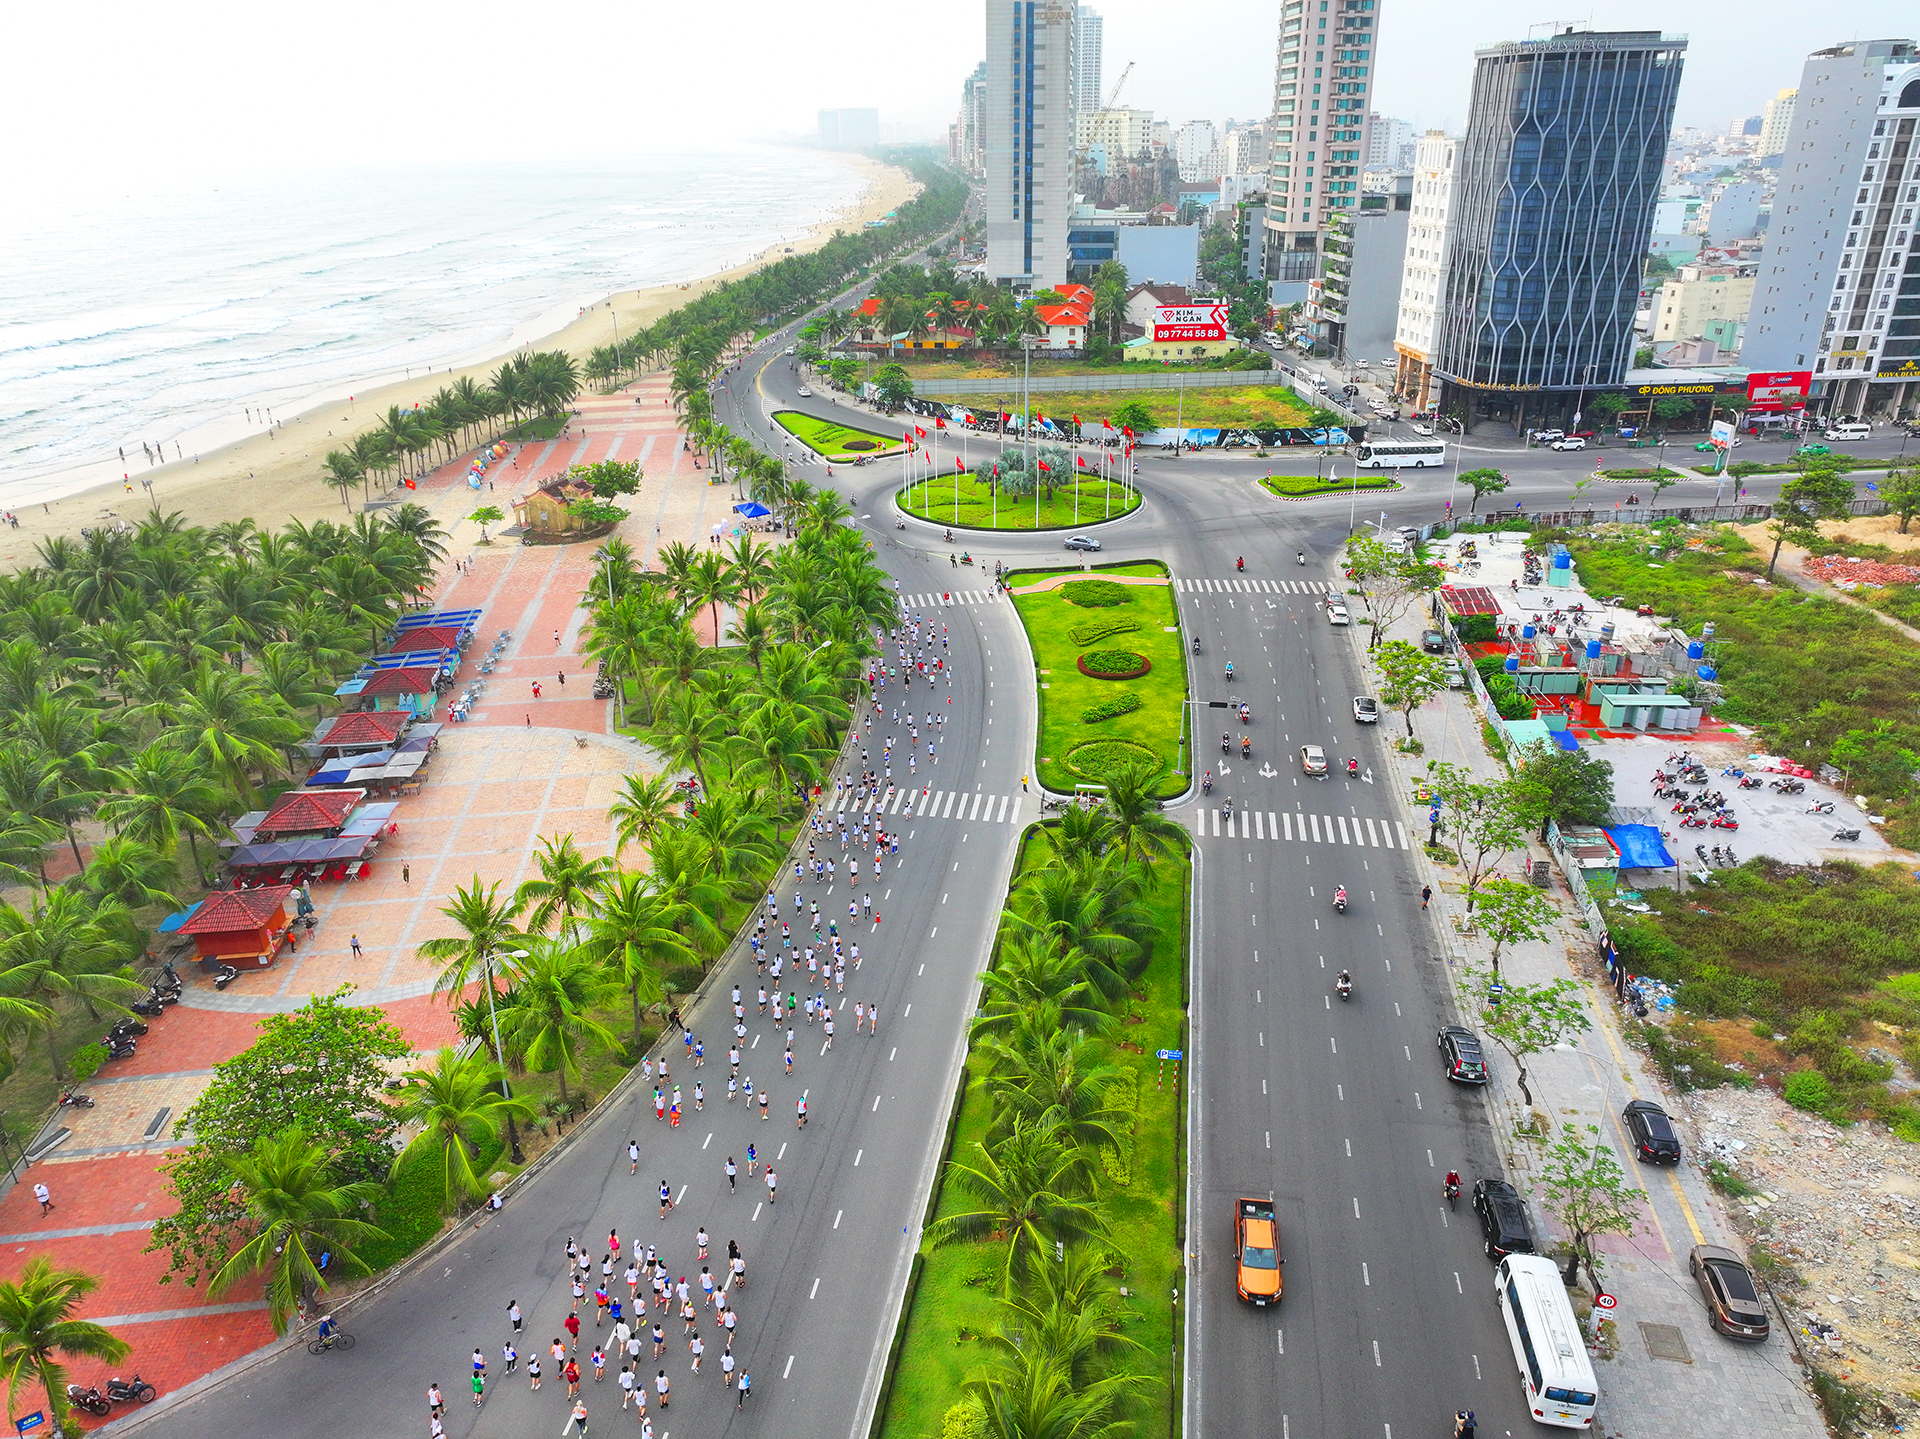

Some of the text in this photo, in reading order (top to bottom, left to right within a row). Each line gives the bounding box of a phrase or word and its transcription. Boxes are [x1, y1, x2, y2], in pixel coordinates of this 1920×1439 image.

[1527, 40, 1569, 53] MARIS
[1573, 39, 1614, 51] BEACH
[1158, 330, 1169, 338] 09
[1170, 330, 1181, 338] 77
[1195, 329, 1206, 337] 55
[1207, 329, 1219, 337] 88
[1478, 382, 1506, 390] MARIS
[1510, 383, 1540, 391] BEACH
[1652, 385, 1676, 395] ĐÔNG
[1677, 385, 1714, 393] PHƯƠNG
